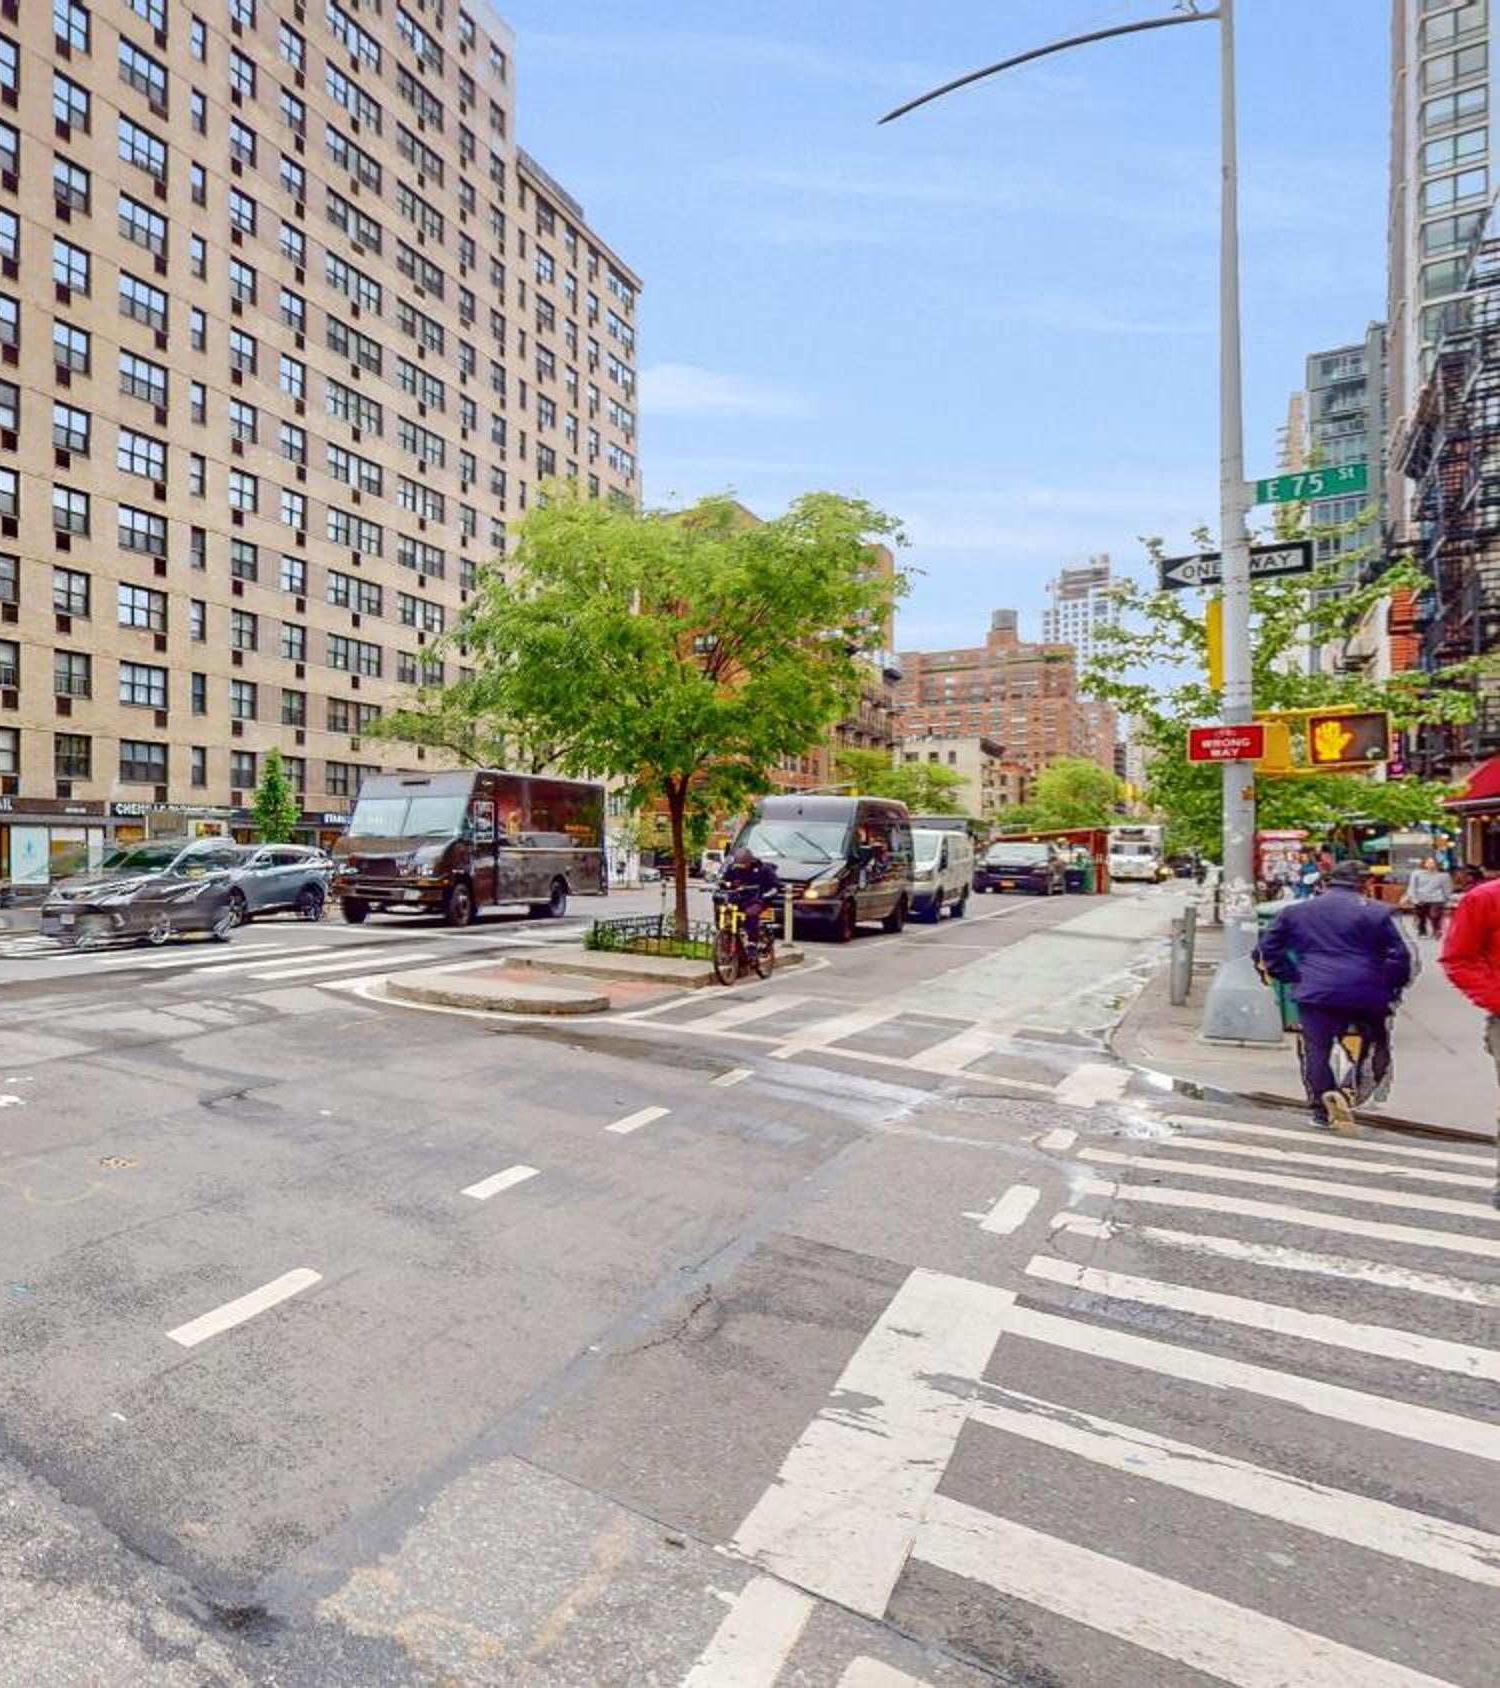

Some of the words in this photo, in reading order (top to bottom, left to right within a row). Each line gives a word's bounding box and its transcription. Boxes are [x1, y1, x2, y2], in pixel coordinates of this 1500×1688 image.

[1267, 482, 1279, 500] E
[1291, 473, 1323, 495] 75
[1338, 467, 1355, 481] St
[1181, 557, 1223, 579] ONE
[1201, 737, 1252, 749] WRONG
[1210, 748, 1240, 757] WAY
